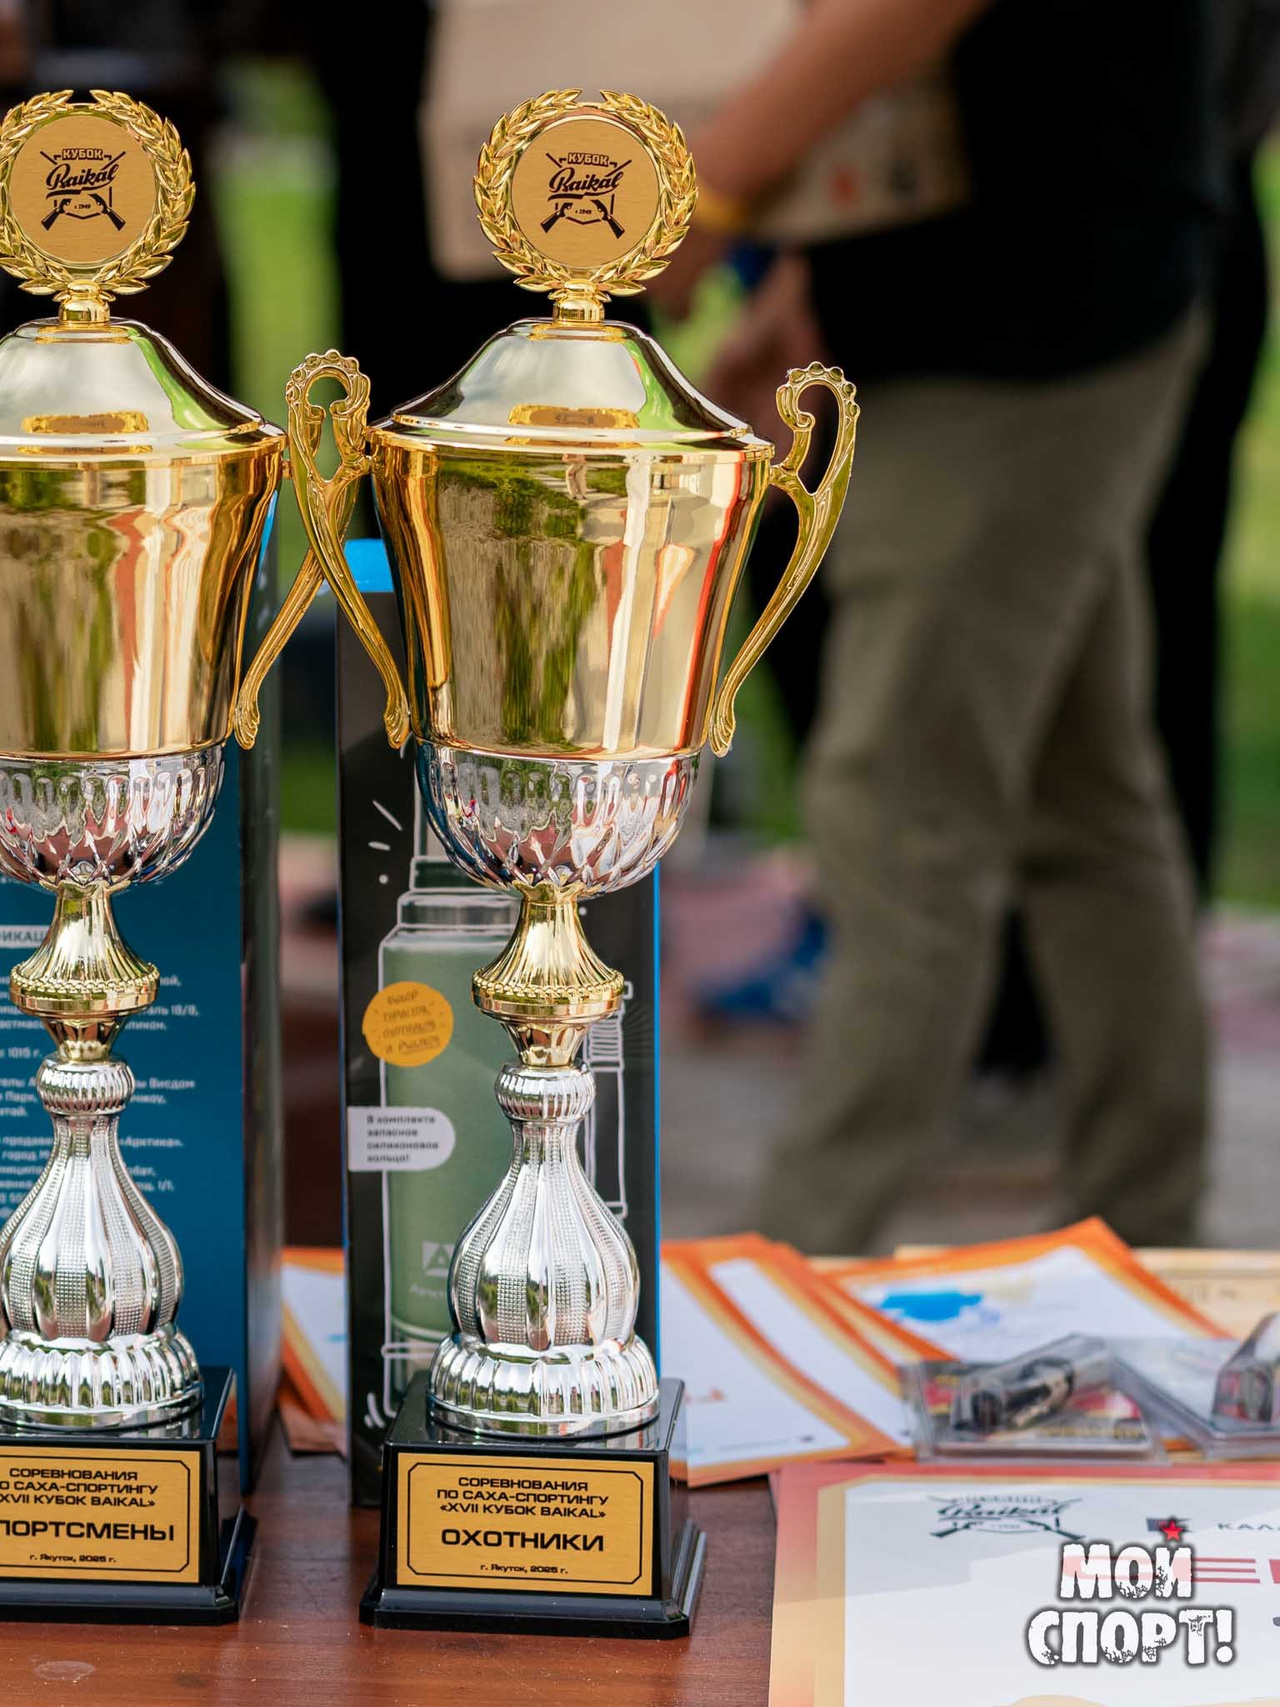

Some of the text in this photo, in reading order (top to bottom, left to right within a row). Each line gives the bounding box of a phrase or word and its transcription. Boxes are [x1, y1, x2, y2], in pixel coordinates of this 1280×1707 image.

[62, 149, 103, 160] КУБОК
[568, 152, 609, 166] КУБОК
[46, 163, 119, 190] Baikal
[549, 167, 623, 193] Baikal
[9, 1468, 138, 1481] СОРЕВНОВАНИЯ
[14, 1481, 158, 1494] САХА-СПОРТИНГУ
[458, 1477, 588, 1491] СОРЕВНОВАНИЯ
[34, 1495, 87, 1506] КУБОК
[91, 1496, 156, 1507] BAIKAL»
[437, 1489, 609, 1505] ПО САХА-СПОРТИНГУ
[440, 1503, 606, 1518] «XVII КУБОК BAIKAL»
[441, 1528, 604, 1552] ОХОТНИКИ
[40, 1553, 76, 1563] Якутск,
[491, 1563, 528, 1573] Якутск,
